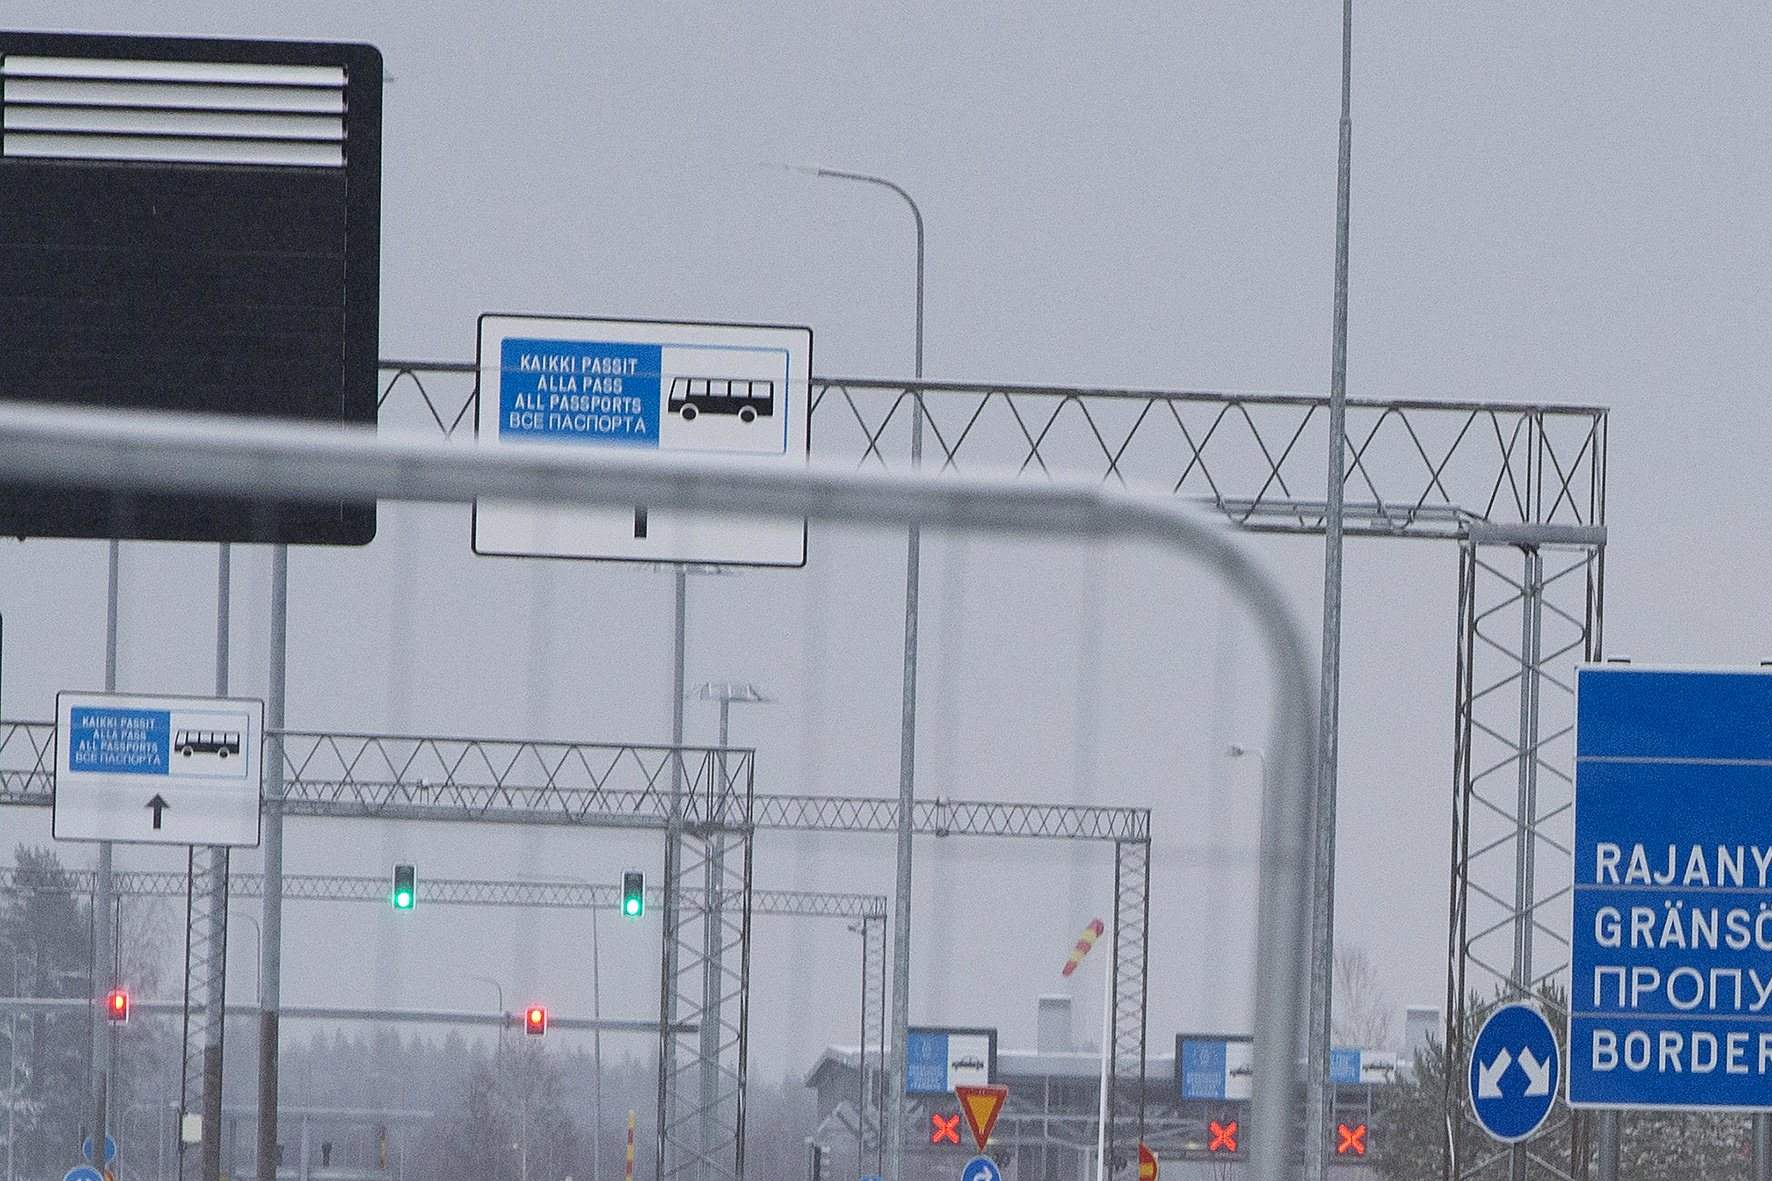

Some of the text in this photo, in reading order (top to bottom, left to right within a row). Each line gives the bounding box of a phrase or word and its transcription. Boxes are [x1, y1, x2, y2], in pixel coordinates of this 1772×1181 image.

[519, 353, 639, 376] KAIKKI PASSIT
[537, 374, 624, 395] ALLA PASS
[514, 392, 643, 414] ALL PASSPORTS
[509, 411, 647, 433] ВСЕ ПАСПОРТА
[82, 715, 118, 729] KAIKKI
[92, 728, 118, 740] ALLA
